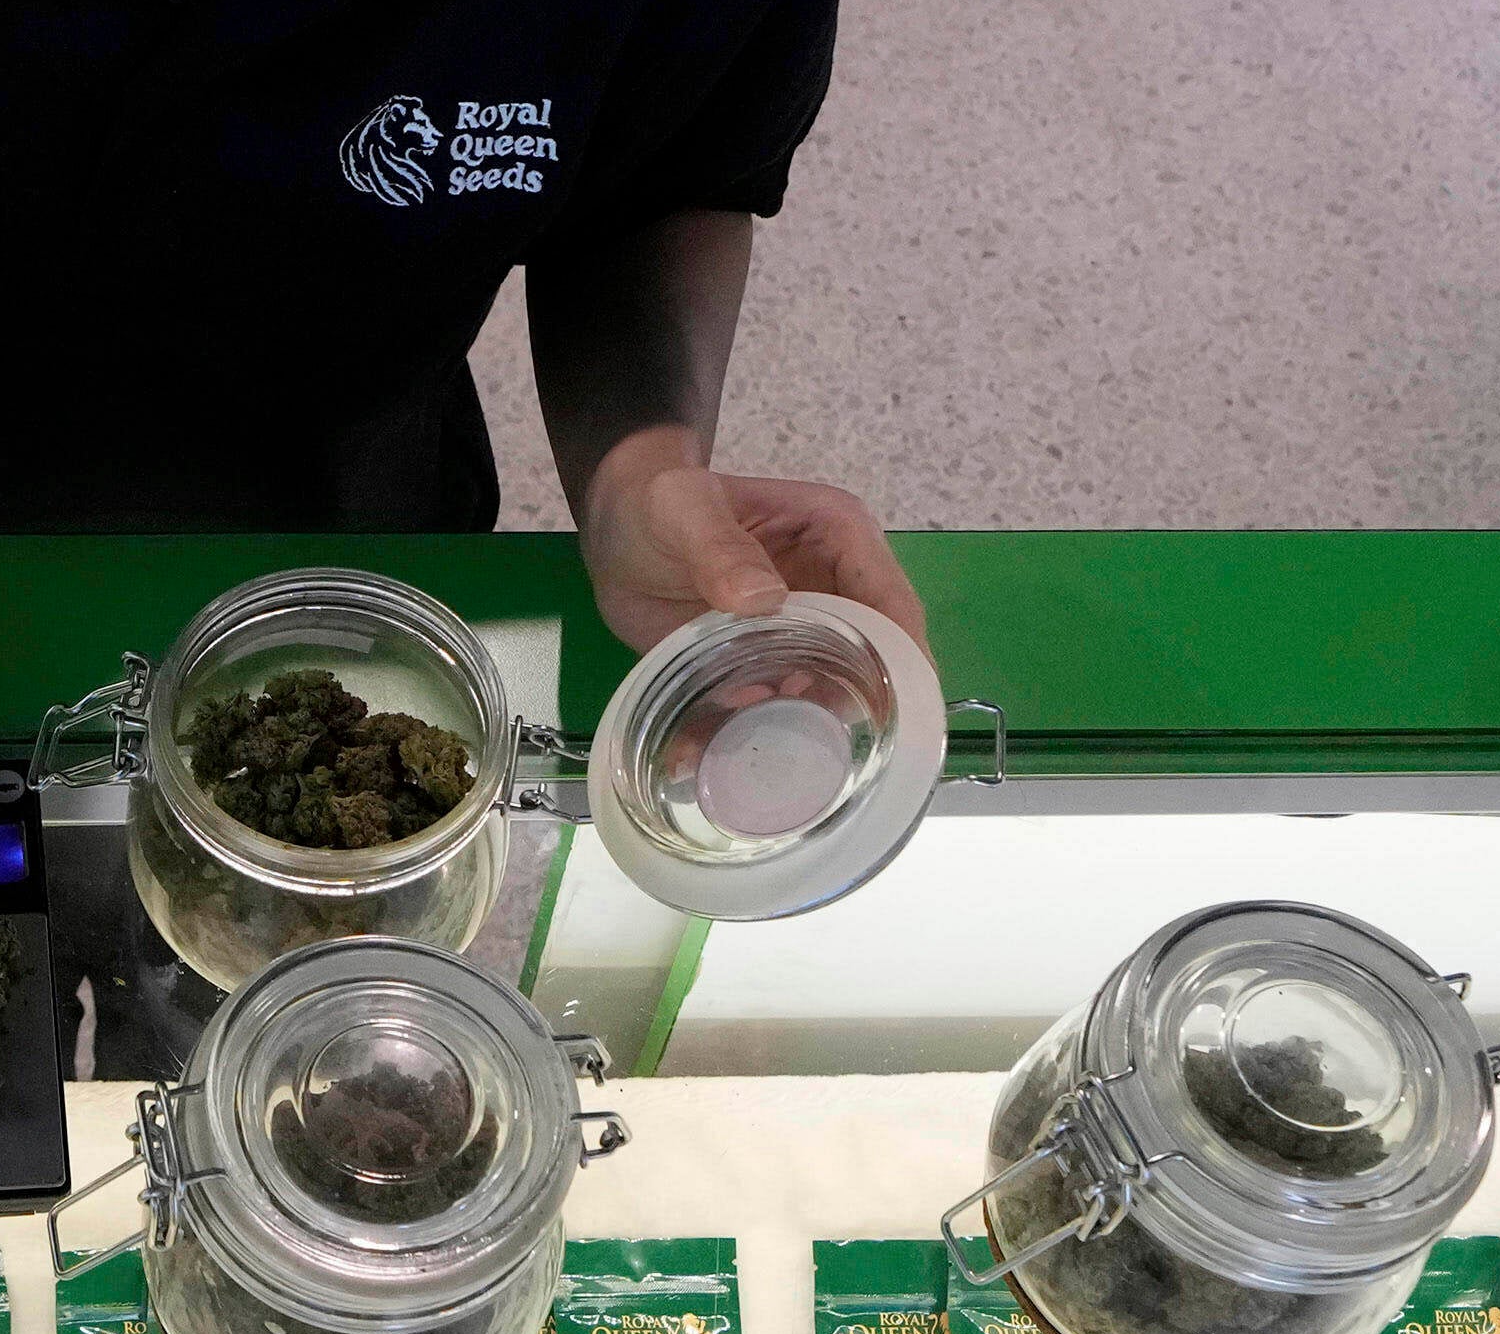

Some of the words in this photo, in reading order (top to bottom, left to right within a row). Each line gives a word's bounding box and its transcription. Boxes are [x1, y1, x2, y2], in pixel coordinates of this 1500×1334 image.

[455, 99, 552, 131] Royal
[450, 134, 559, 167] Queen
[449, 162, 544, 195] Seeds
[622, 1315, 669, 1329] ROYAL
[879, 1312, 927, 1327] ROYAL
[1435, 1309, 1479, 1324] ROYAL
